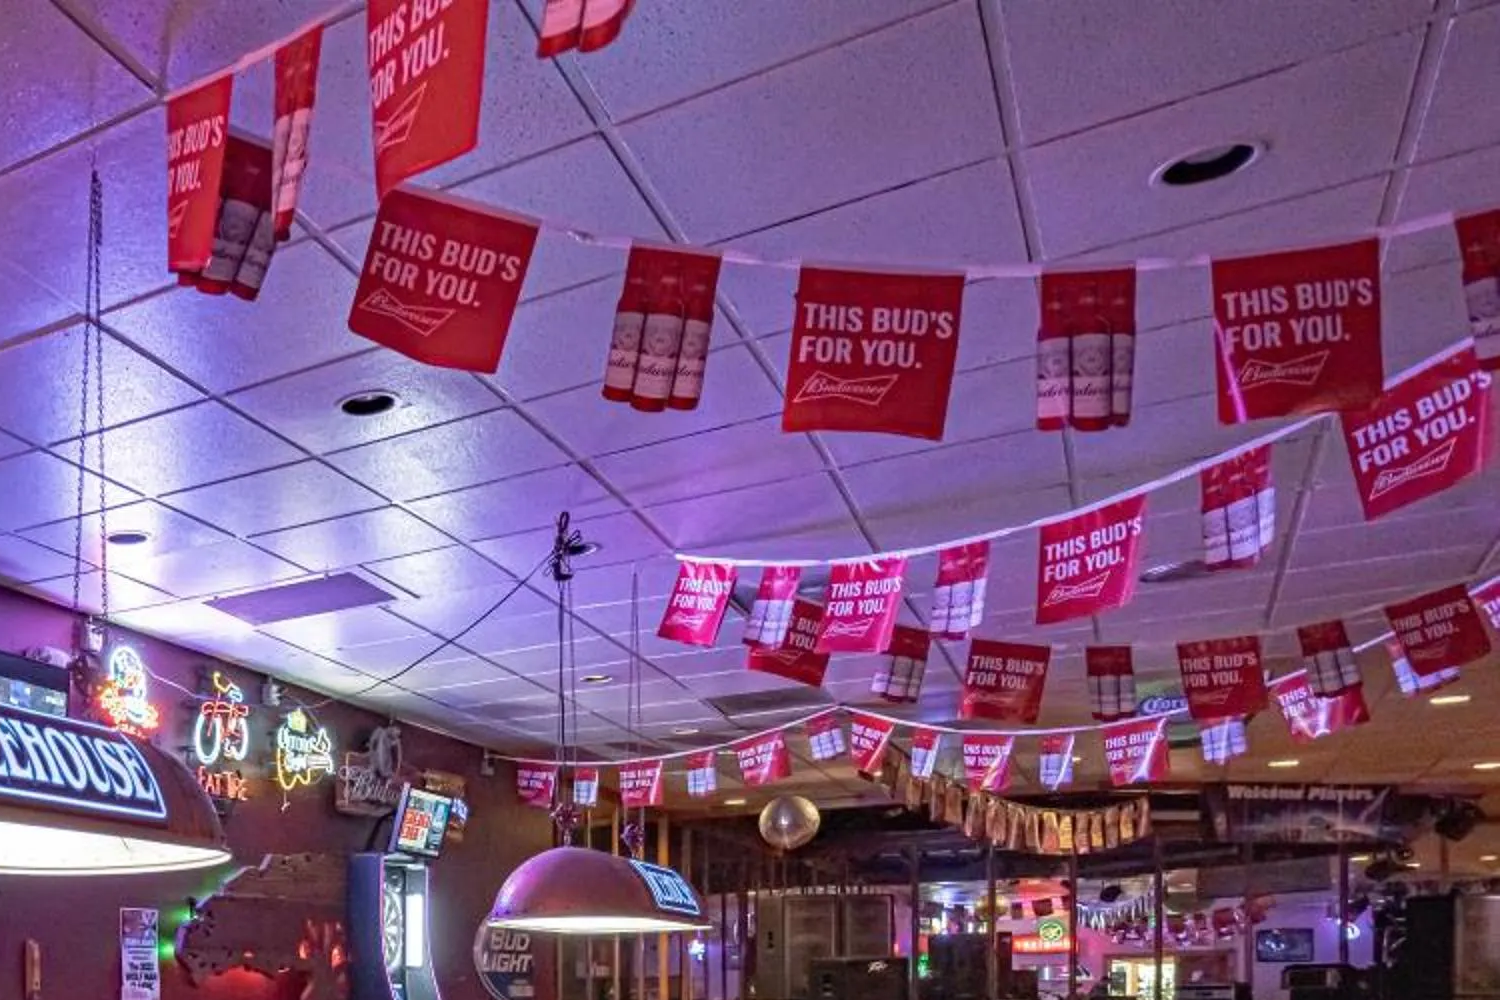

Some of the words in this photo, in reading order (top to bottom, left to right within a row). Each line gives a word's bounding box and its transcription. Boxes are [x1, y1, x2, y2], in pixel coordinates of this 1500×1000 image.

[369, 2, 407, 68] THIS
[372, 58, 396, 109] OR
[402, 20, 450, 86] YOU.
[379, 220, 437, 261] THIS
[439, 239, 521, 282] BUD'S
[369, 250, 419, 291] FOR
[425, 268, 481, 308] YOU.
[1222, 287, 1290, 321] THIS
[1294, 277, 1374, 311] BUD'S
[802, 302, 863, 334] THIS
[870, 307, 955, 340] BUD'S
[1224, 322, 1282, 354] FOR
[1289, 314, 1351, 346] YOU.
[798, 335, 853, 365] FOR
[861, 338, 923, 370] YOU.
[1351, 408, 1412, 450] THIS
[1414, 369, 1493, 417] BUD'S
[1356, 435, 1410, 474] FOR
[1412, 406, 1476, 448] YOU.
[1043, 535, 1086, 562] THIS
[1089, 515, 1143, 548] BUD'S
[1043, 559, 1080, 583] FOR
[1084, 545, 1125, 573] YOU.
[831, 580, 862, 598] THIS
[864, 577, 902, 595] BUD'S
[826, 601, 854, 616] FOR
[857, 598, 886, 615] YOU.
[967, 671, 997, 687] FOR
[971, 655, 1003, 671] THIS
[1005, 657, 1045, 675] BUD'S
[1181, 656, 1212, 672] THIS
[1213, 651, 1258, 668] BUD'S
[1184, 673, 1209, 688] FOR
[1211, 670, 1243, 685] YOU.
[1227, 785, 1304, 799] Welcome
[489, 929, 530, 951] BUD
[482, 951, 533, 973] LIGHT
